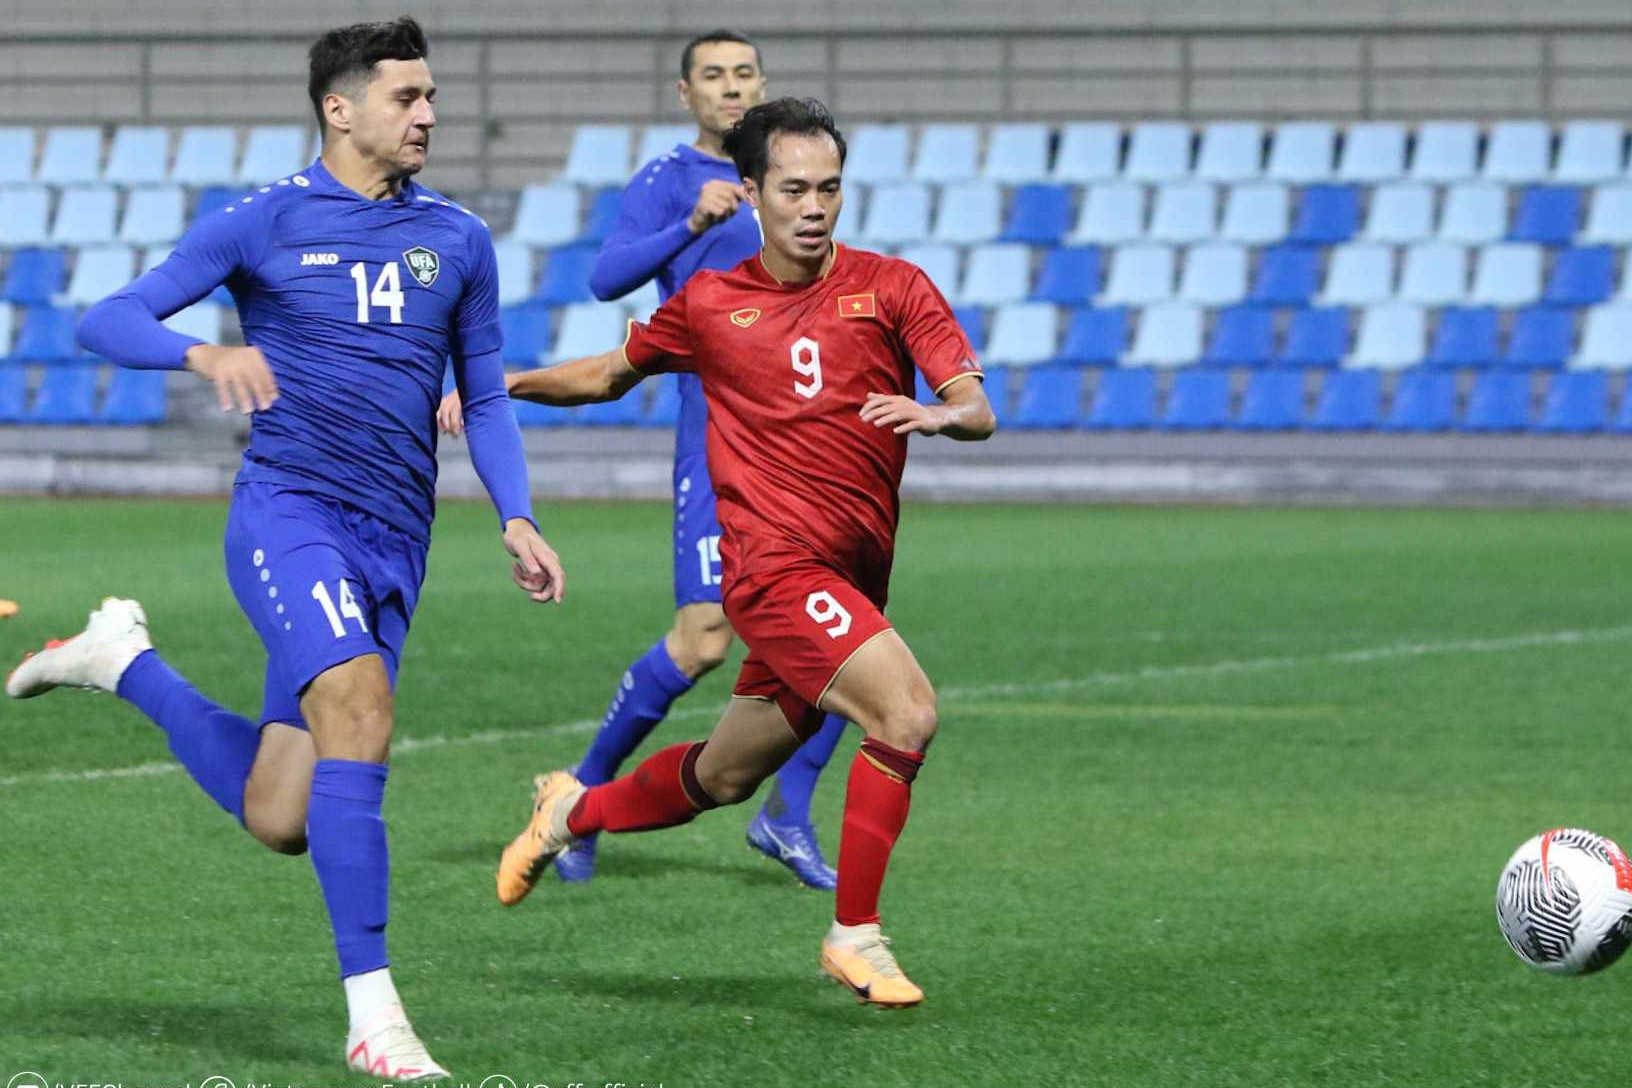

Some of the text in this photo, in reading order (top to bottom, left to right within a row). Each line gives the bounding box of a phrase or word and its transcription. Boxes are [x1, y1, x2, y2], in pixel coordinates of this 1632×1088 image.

[300, 253, 340, 266] JAKO
[408, 252, 437, 269] UFA
[350, 261, 405, 324] 14
[790, 336, 824, 399] 9
[311, 577, 369, 639] 14
[805, 590, 853, 639] 9
